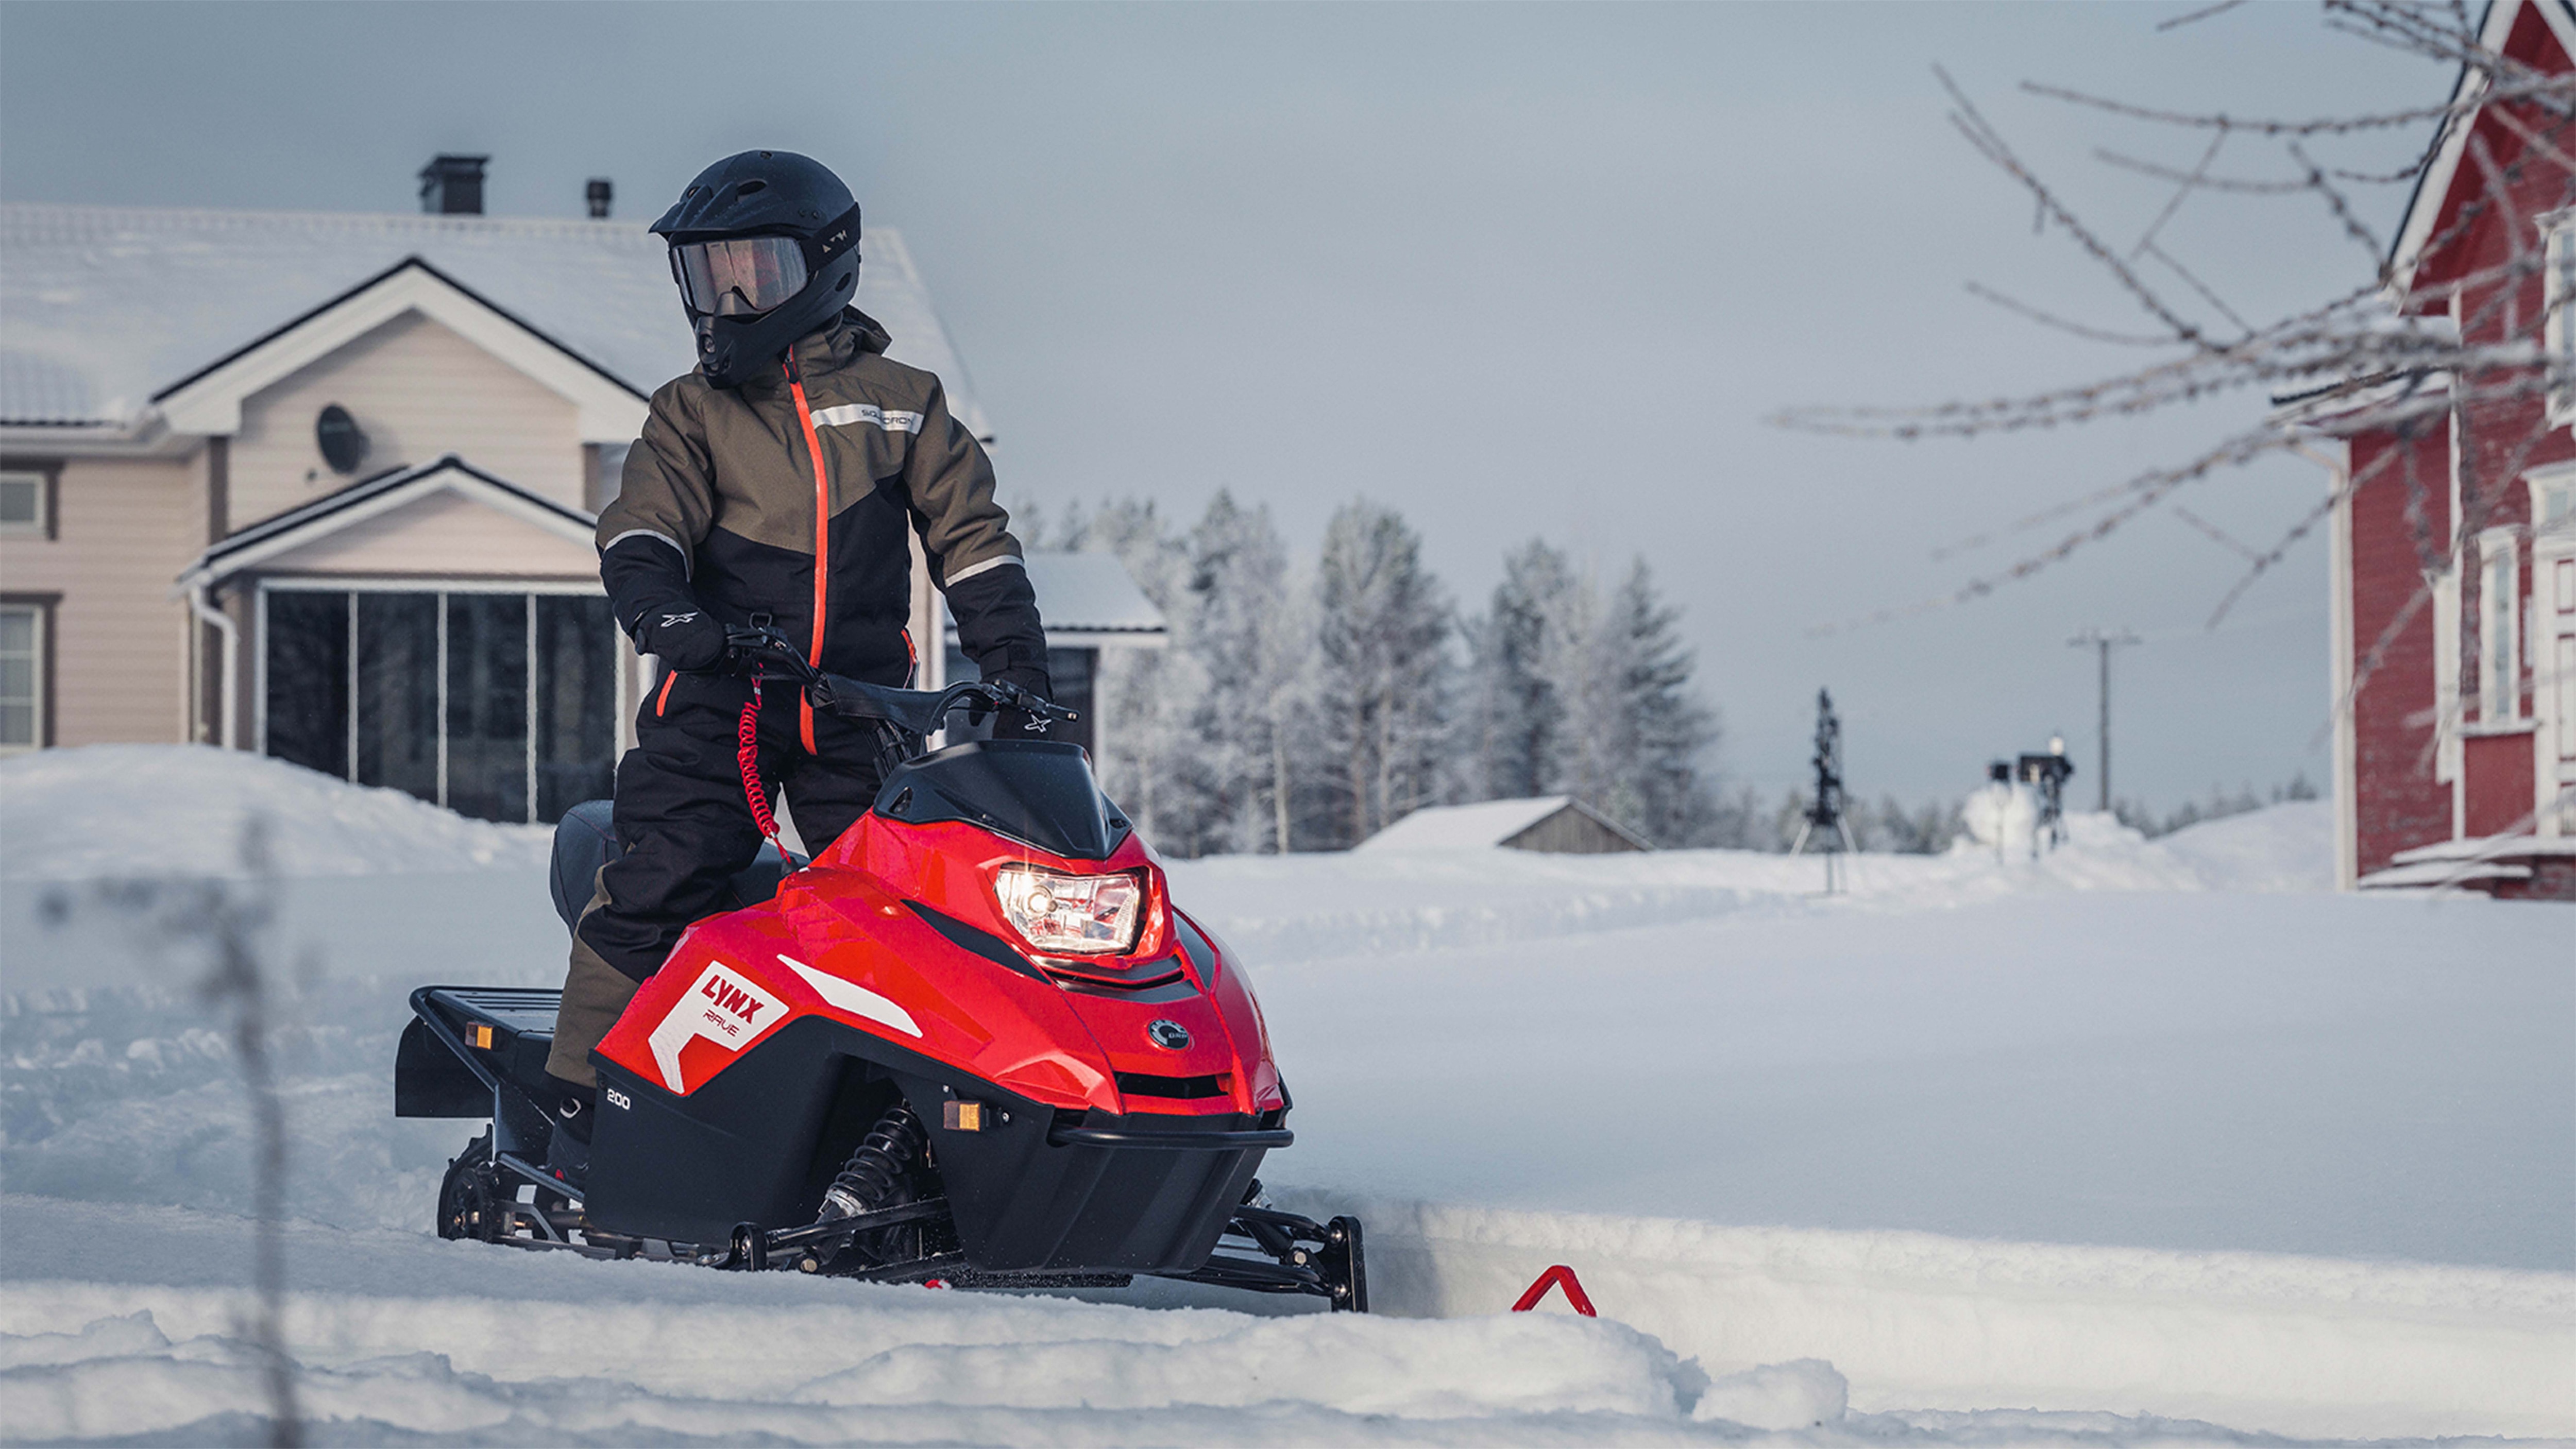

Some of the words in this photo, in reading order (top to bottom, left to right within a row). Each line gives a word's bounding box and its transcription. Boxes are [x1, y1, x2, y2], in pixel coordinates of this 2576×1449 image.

[701, 975, 764, 1025] LYNX
[703, 1009, 740, 1037] RAVE
[607, 1088, 630, 1110] 200
